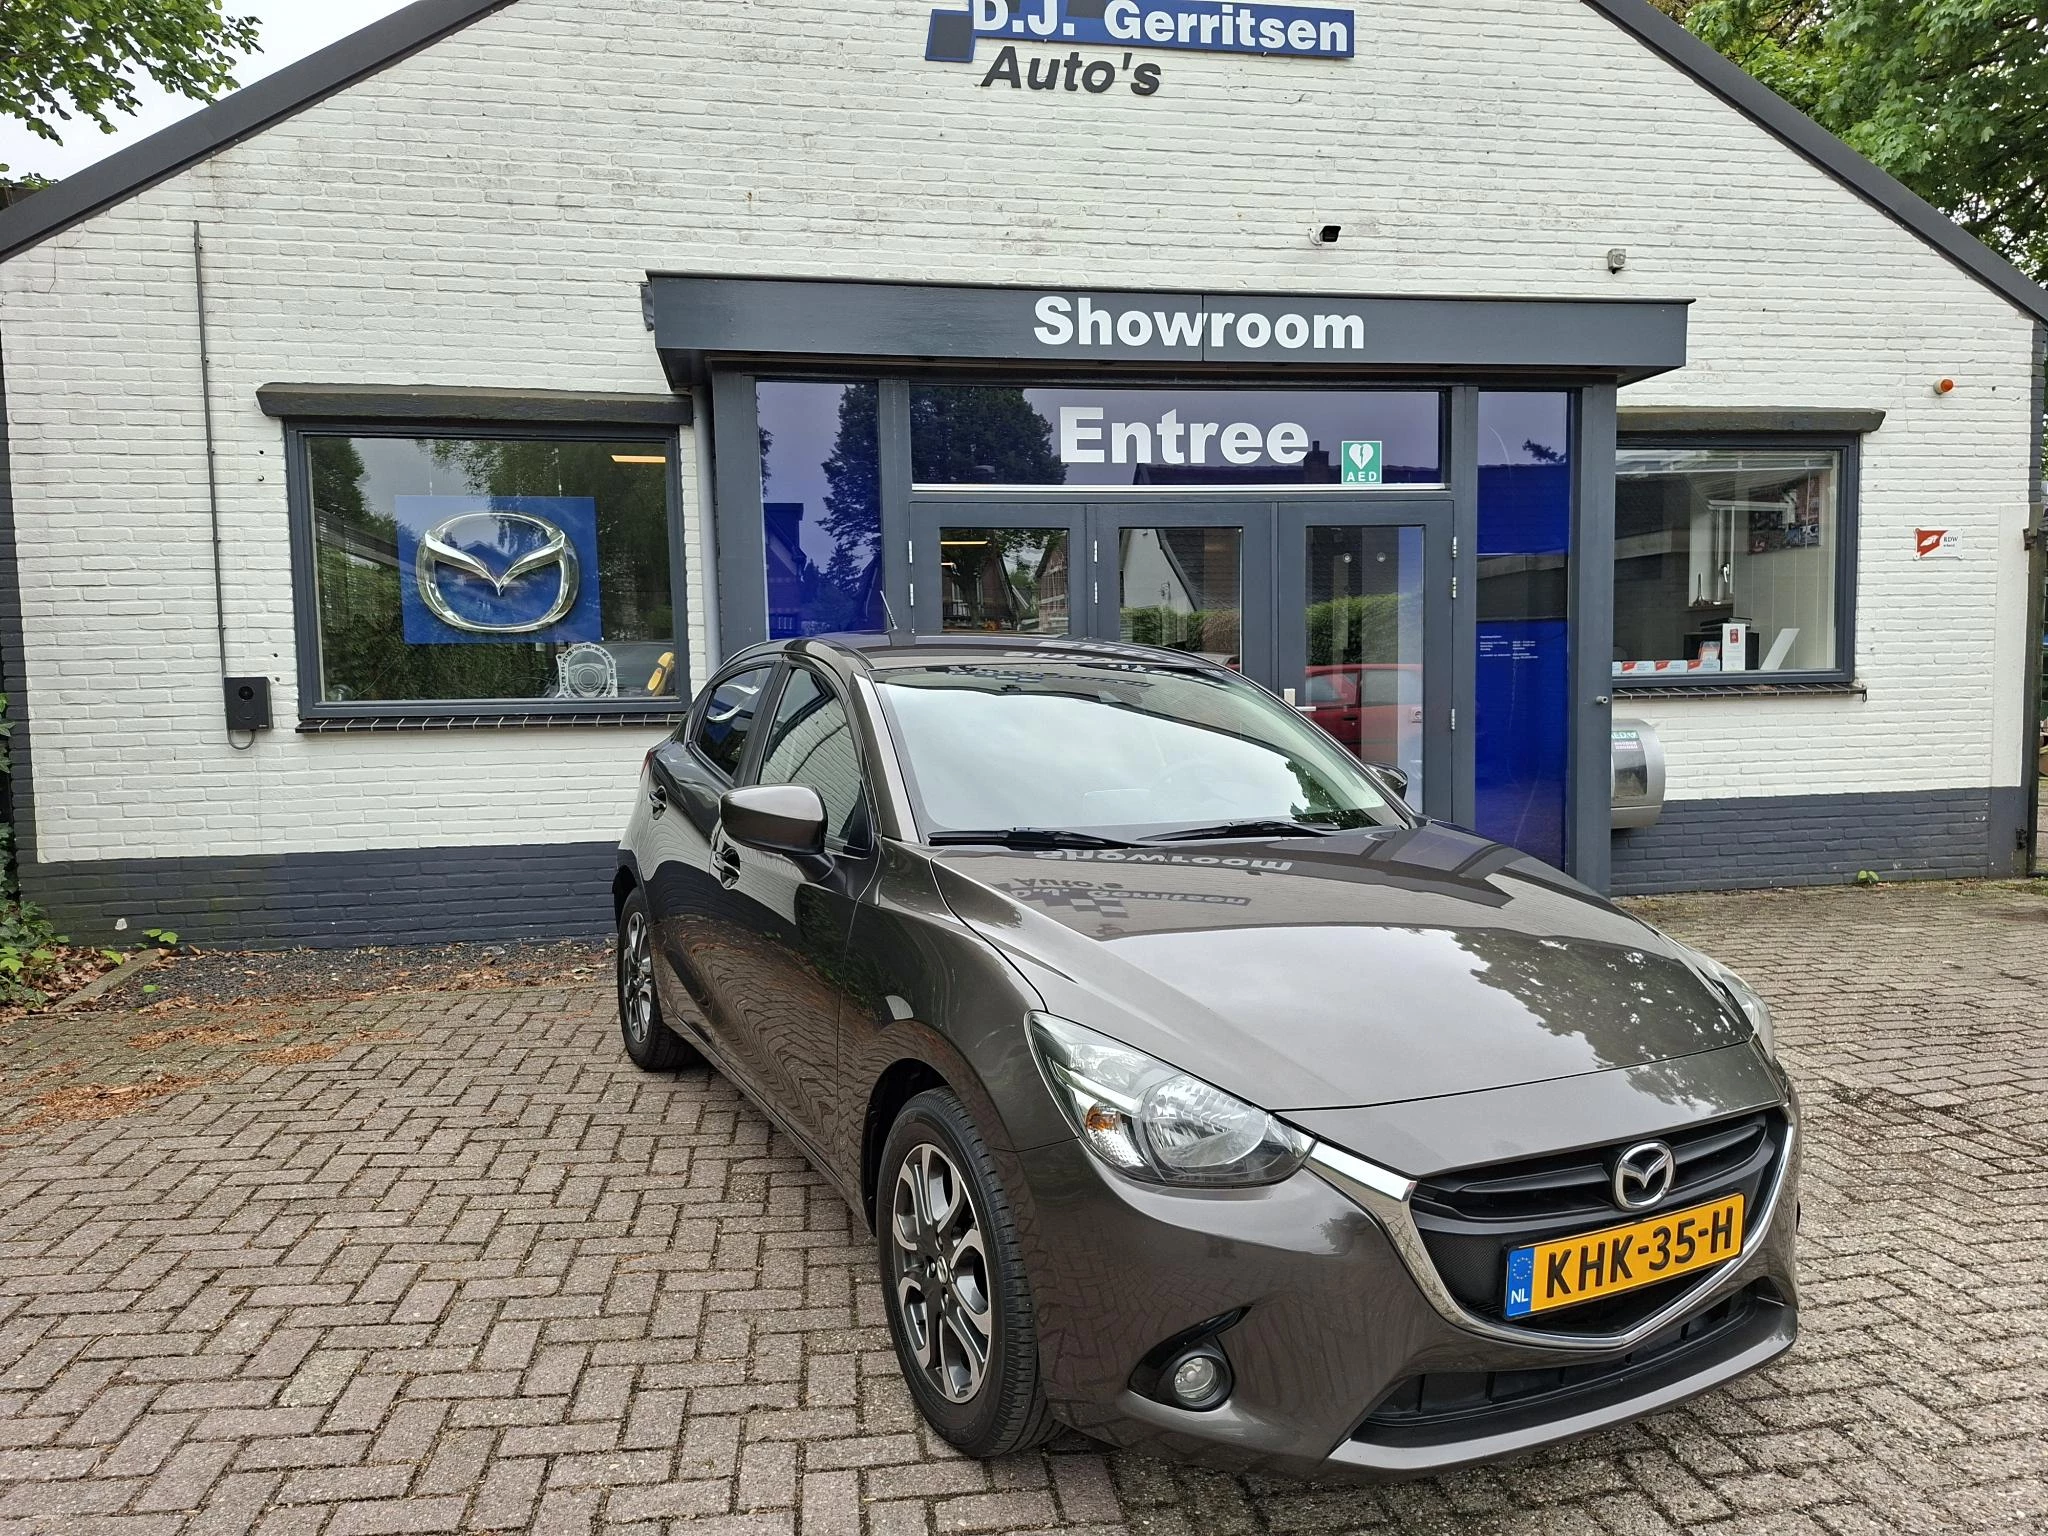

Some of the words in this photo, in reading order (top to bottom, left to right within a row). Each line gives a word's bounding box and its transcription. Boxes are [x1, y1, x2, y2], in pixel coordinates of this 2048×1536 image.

[973, 0, 1075, 36] D.J.
[1104, 0, 1348, 52] Gerritsen
[980, 45, 1162, 96] Auto's
[1033, 296, 1365, 349] Showroom
[1059, 406, 1309, 464] Entree
[1346, 471, 1377, 482] AED
[1546, 1206, 1734, 1299] KHK-35-H
[1511, 1288, 1529, 1305] NL
